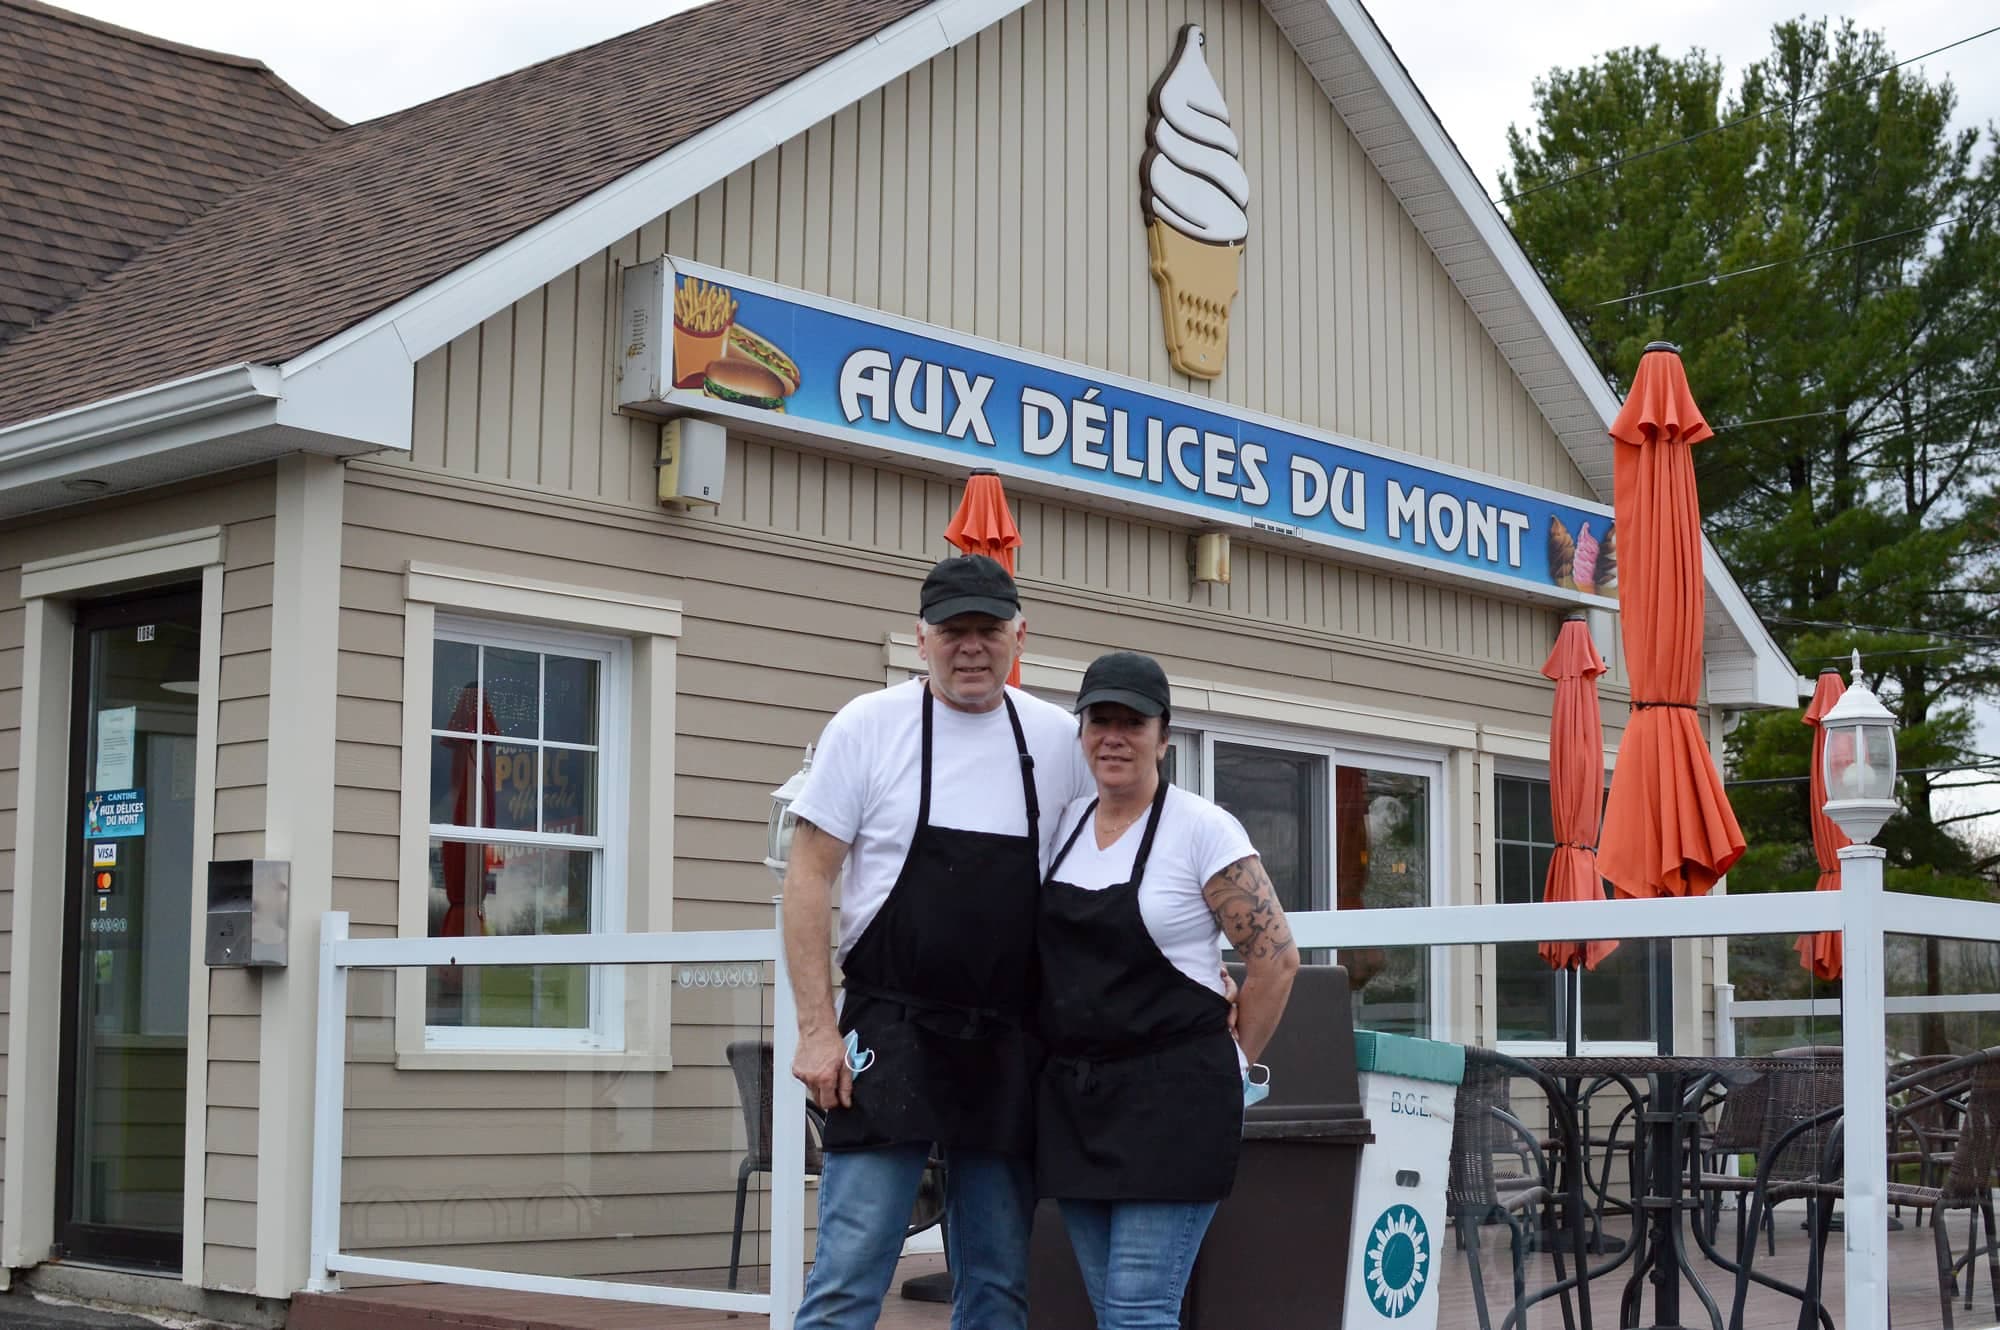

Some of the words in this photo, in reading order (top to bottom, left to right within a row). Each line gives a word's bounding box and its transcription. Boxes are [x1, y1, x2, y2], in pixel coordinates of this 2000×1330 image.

[839, 347, 996, 447] AUX
[1020, 386, 1270, 507] DÉLICES
[1290, 454, 1367, 532] DU
[1386, 479, 1530, 568] MONT
[107, 791, 137, 801] CANTINE
[100, 804, 115, 817] AUX
[106, 815, 117, 826] DU
[118, 814, 139, 825] MONT
[97, 847, 114, 859] VISA
